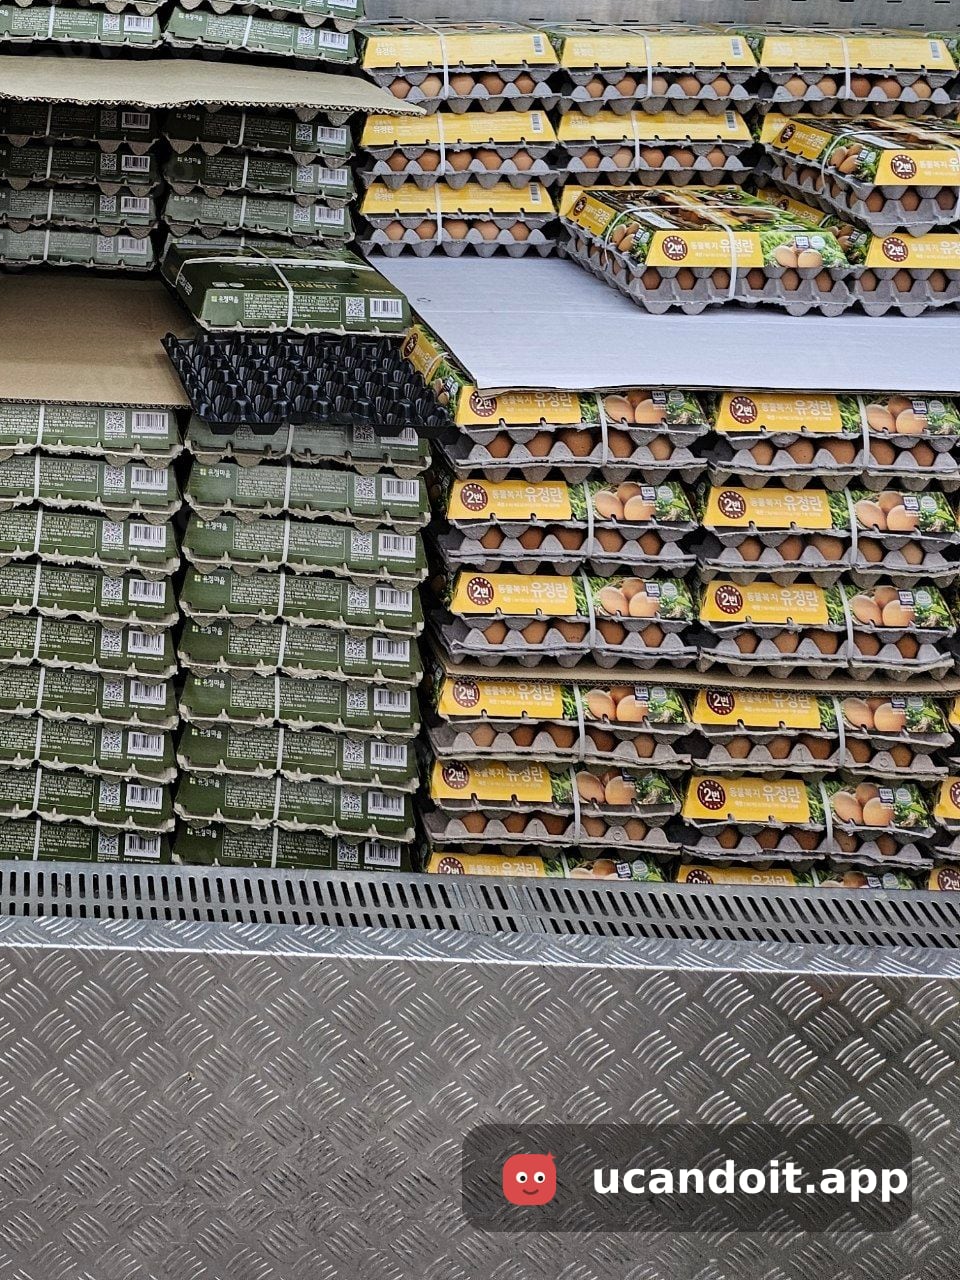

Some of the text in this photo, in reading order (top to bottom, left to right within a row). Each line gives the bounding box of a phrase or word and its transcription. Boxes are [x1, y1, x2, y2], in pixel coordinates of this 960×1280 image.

[898, 161, 913, 172] 2번
[669, 243, 683, 253] 2번
[888, 245, 903, 255] 2번
[535, 392, 572, 407] 유정란
[736, 405, 756, 416] 2번
[794, 401, 831, 416] 유정란
[466, 493, 485, 504] 2번
[525, 484, 562, 502] 유정란
[725, 499, 742, 511] 2번
[785, 495, 822, 513] 유정란
[473, 585, 492, 599] 2번
[532, 582, 567, 598] 유정란
[781, 589, 818, 605] 유정란
[721, 593, 741, 606] 2번
[459, 687, 478, 701] 2번
[518, 684, 555, 700] 유정란
[703, 788, 722, 801] 2번
[764, 787, 800, 802] 유정란
